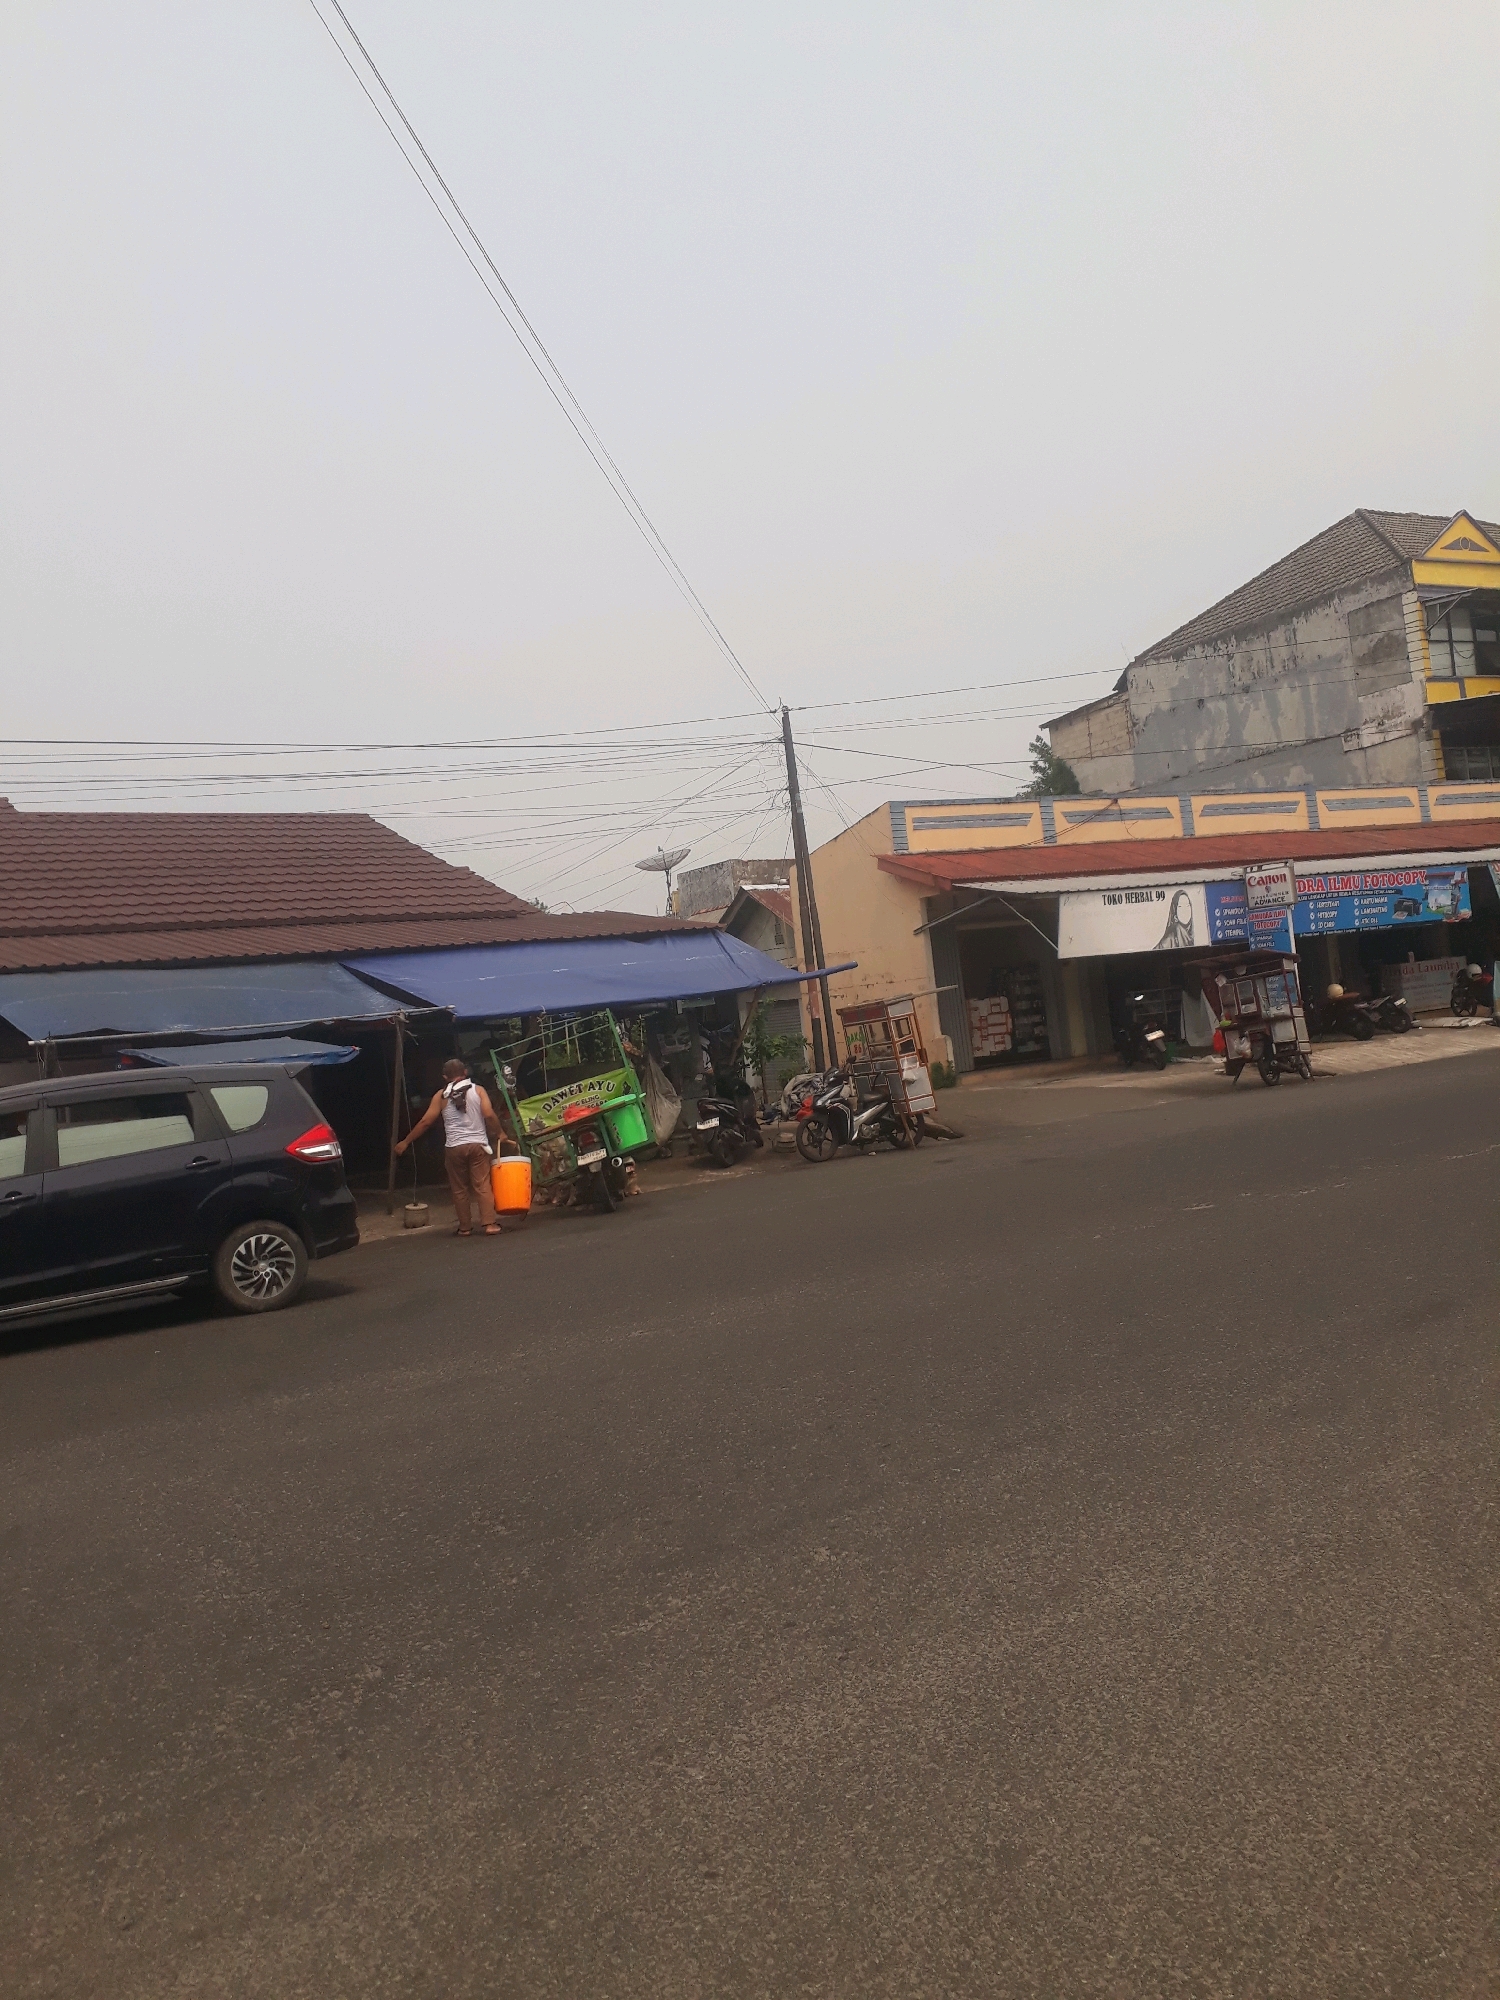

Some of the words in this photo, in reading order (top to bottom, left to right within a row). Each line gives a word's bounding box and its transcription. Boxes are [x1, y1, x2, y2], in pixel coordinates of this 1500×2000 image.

[1248, 873, 1286, 887] Canon
[1327, 875, 1361, 892] ILMU
[1363, 870, 1426, 888] FOTOCOPY
[1102, 893, 1123, 906] TOKO
[1125, 890, 1154, 904] HERBAL
[1155, 890, 1166, 901] 99
[1254, 896, 1286, 906] ADVANCE
[1418, 962, 1460, 973] Laundry
[542, 1083, 584, 1113] DAWET
[587, 1080, 615, 1092] AYU
